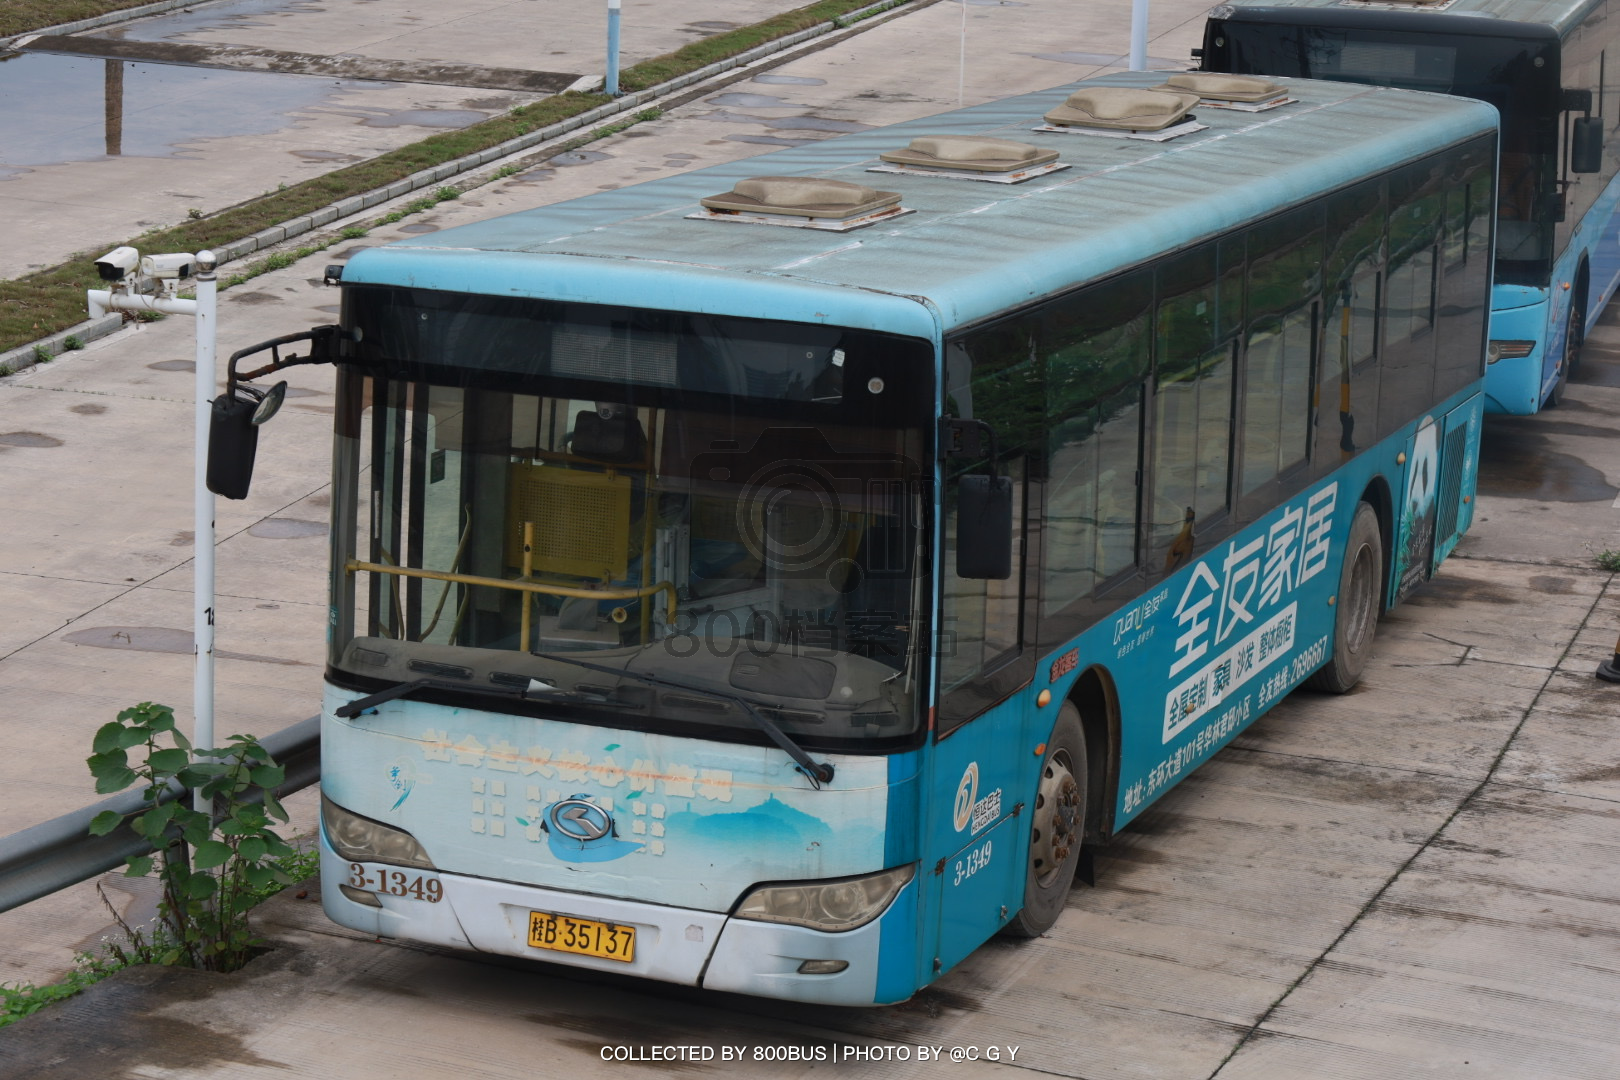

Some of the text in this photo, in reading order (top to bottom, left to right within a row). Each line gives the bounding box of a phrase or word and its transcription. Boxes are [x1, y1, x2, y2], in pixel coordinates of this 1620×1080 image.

[1168, 481, 1338, 679] 全友家居
[1167, 672, 1209, 731] 全屋定制
[1235, 641, 1255, 680] 沙发
[974, 789, 1001, 820] 恒达巴士
[349, 862, 443, 903] 3-1349
[954, 840, 992, 886] 3-1349
